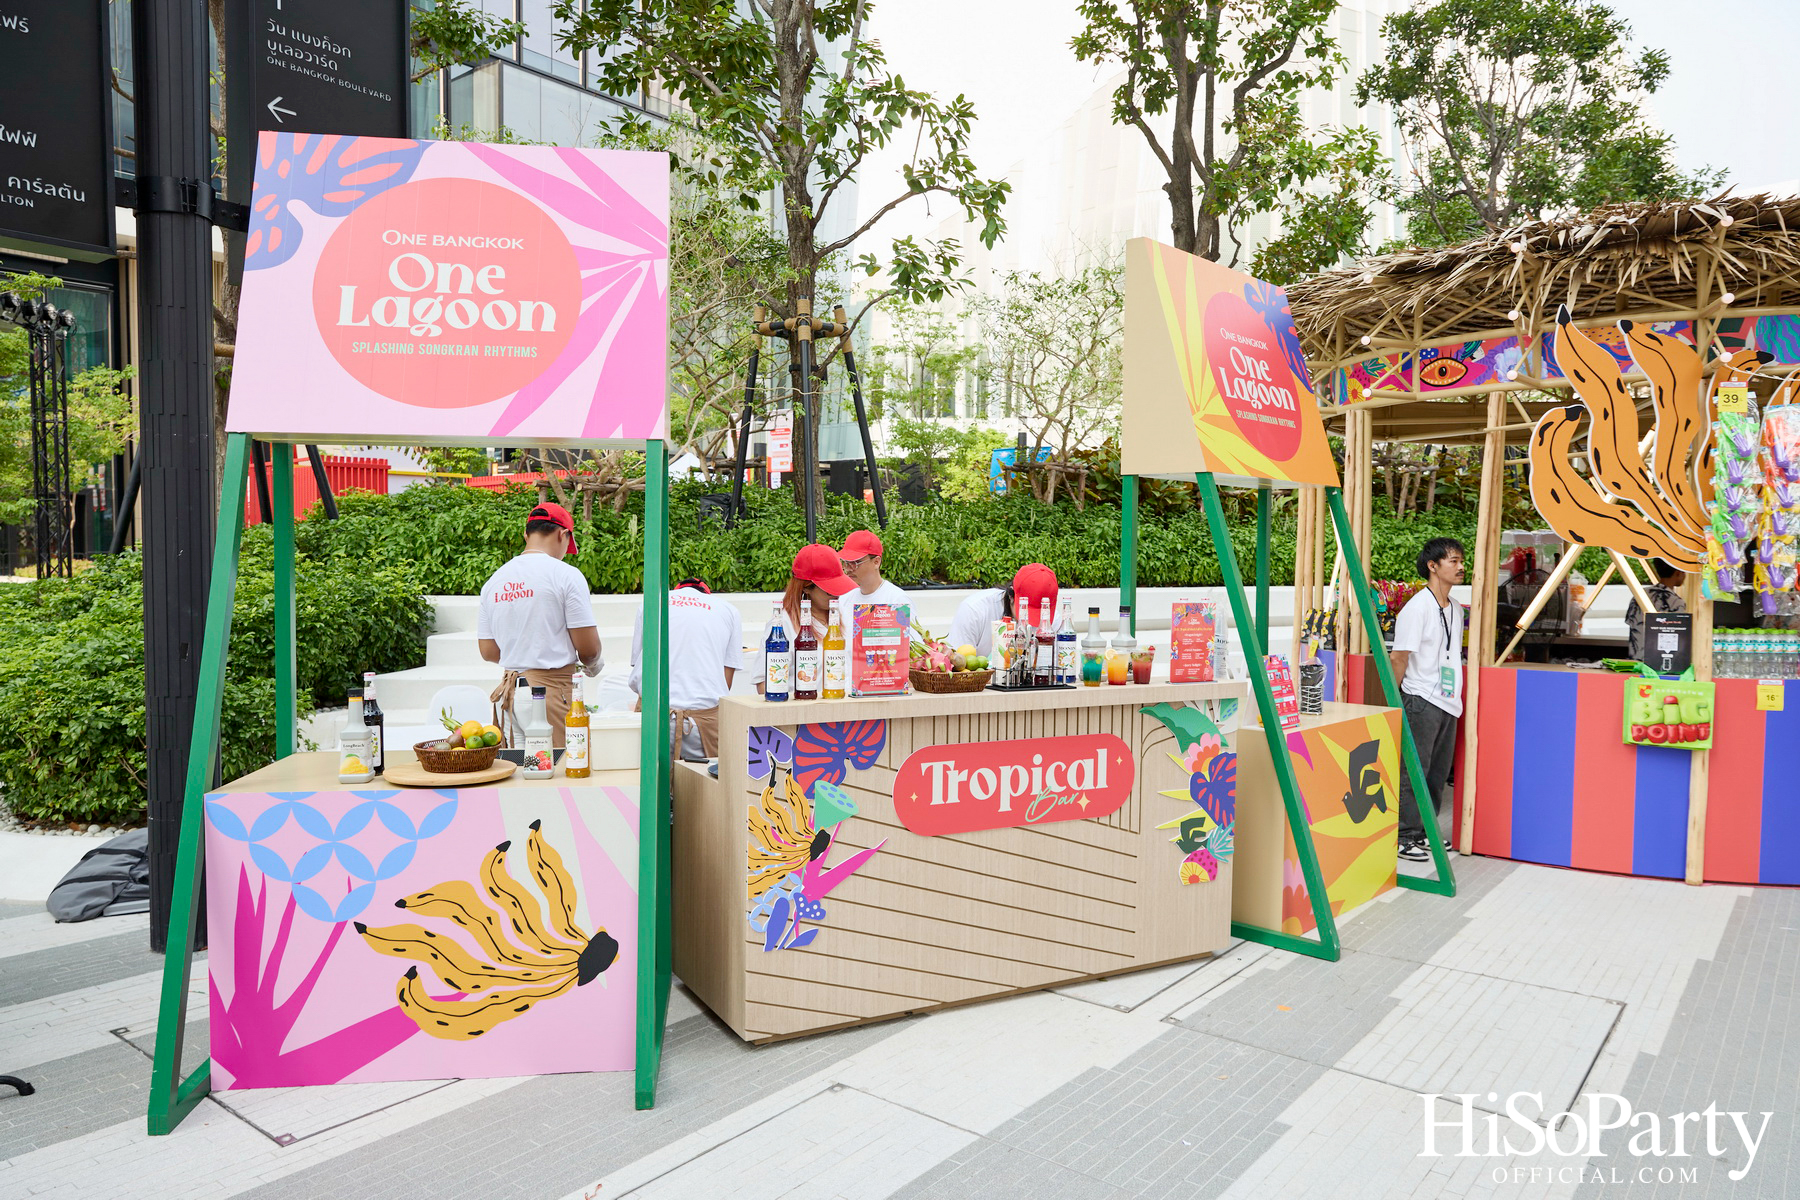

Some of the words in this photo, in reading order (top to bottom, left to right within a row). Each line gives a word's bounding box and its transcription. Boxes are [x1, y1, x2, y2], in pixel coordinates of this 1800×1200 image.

[0, 10, 29, 33] ฟร์
[267, 18, 286, 36] วัน
[291, 29, 352, 58] แบงค็อก
[267, 39, 338, 71] บูเลอวาร์ด
[266, 55, 287, 69] ONE
[290, 63, 336, 84] BANGKOK
[338, 78, 392, 102] BOULEVARD
[7, 176, 86, 203] คาร์ลตัน
[382, 229, 427, 246] ONE
[432, 234, 525, 250] BANGKOK
[388, 252, 506, 295] One
[336, 285, 557, 338] Lagoon
[351, 341, 415, 355] SPLASHING
[418, 343, 479, 357] SONGKRAN
[484, 345, 538, 358] RHYTHMS
[1220, 327, 1237, 341] ONE
[1237, 334, 1269, 351] BANGKOK
[1229, 346, 1272, 382] One
[1218, 366, 1297, 411] Lagoon
[1723, 394, 1739, 404] 39
[494, 588, 534, 603] Lagoon
[503, 581, 525, 592] One
[670, 599, 711, 611] agoon
[1766, 694, 1776, 702] 16
[1631, 722, 1711, 744] POINT
[920, 748, 1109, 813] Tropical
[1024, 785, 1079, 823] Bar
